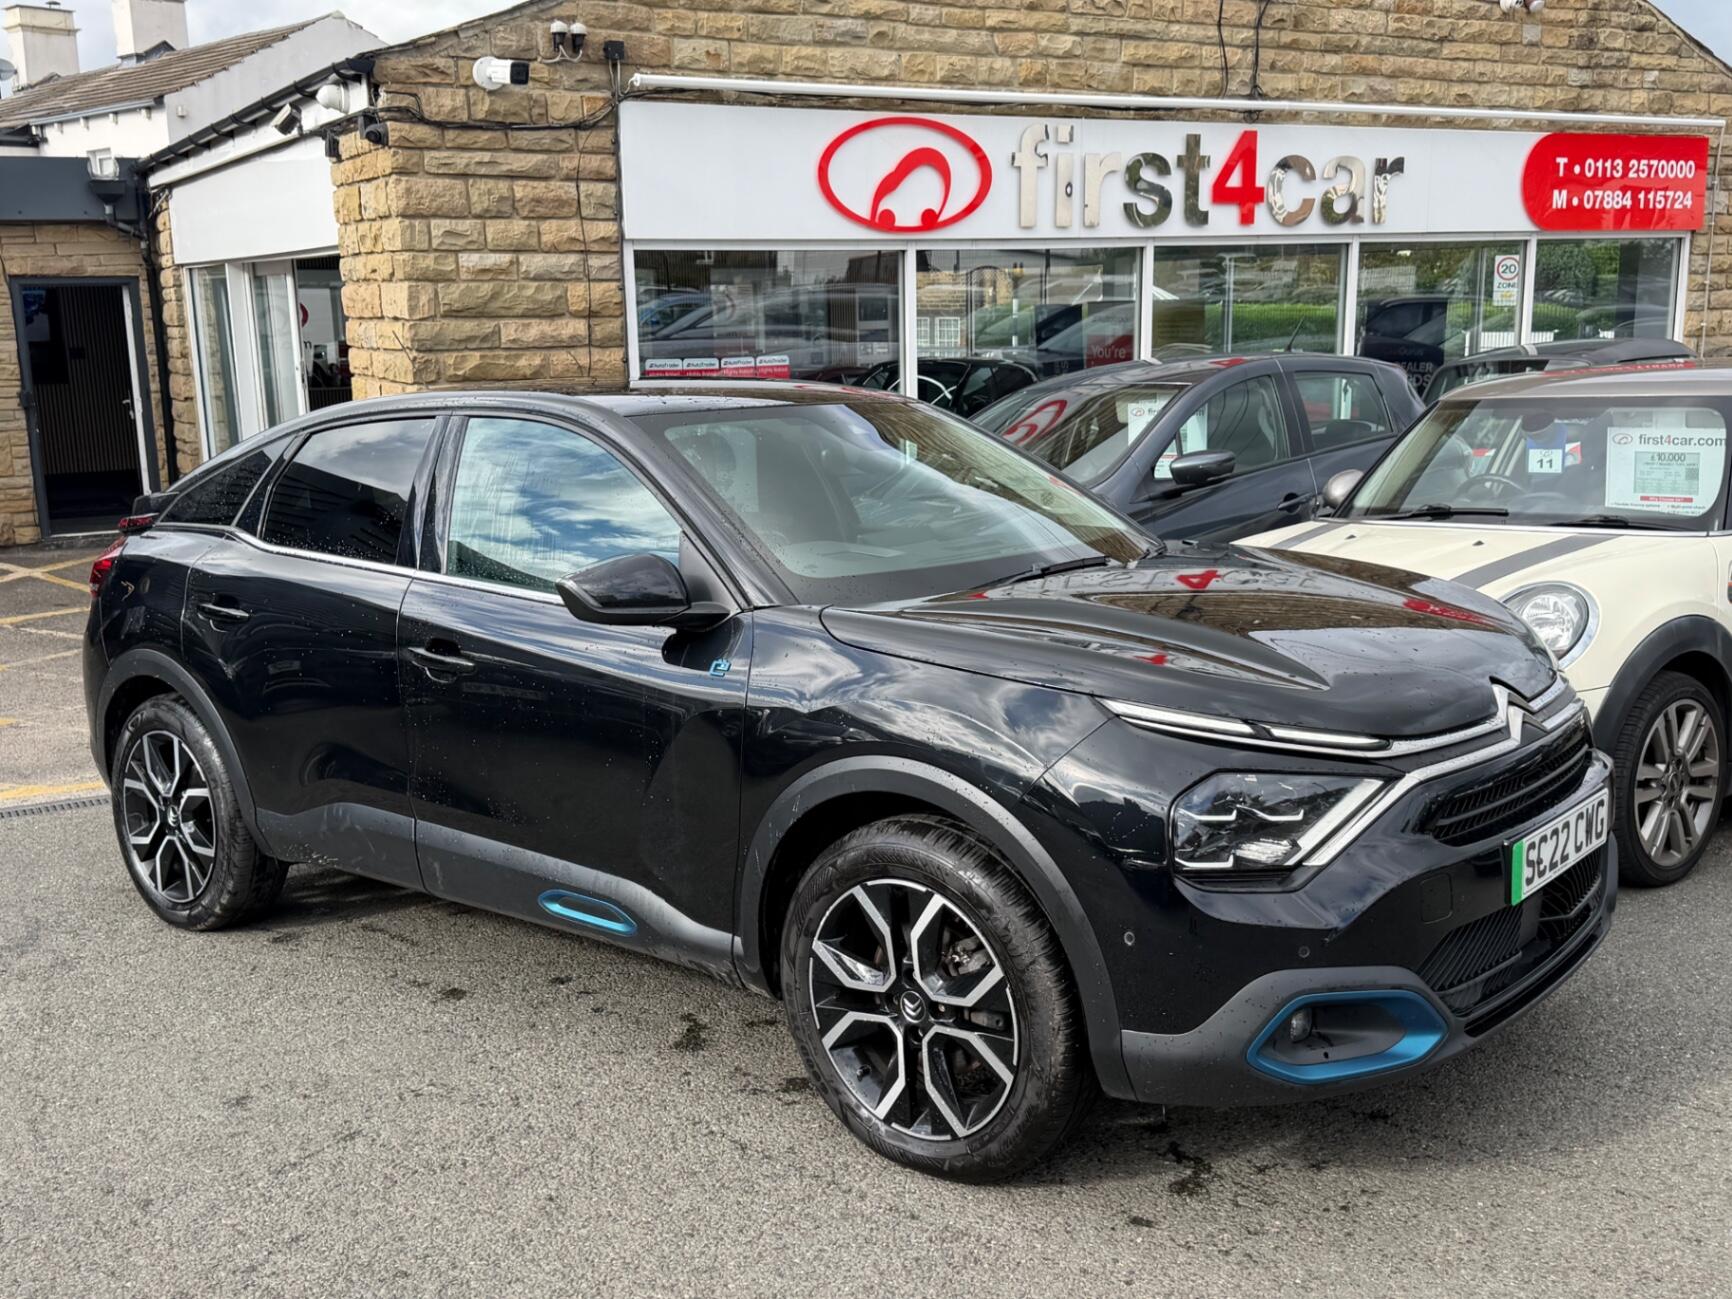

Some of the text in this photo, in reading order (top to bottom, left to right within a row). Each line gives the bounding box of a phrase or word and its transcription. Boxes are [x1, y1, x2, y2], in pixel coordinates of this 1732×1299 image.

[1011, 123, 1405, 229] first4car
[1555, 157, 1696, 179] T 0113 2570000
[1552, 189, 1692, 209] M 07884 115724
[1501, 263, 1517, 274] 20
[1091, 345, 1126, 359] You're
[1537, 458, 1553, 469] 11
[1525, 798, 1605, 886] SE22 CWG
